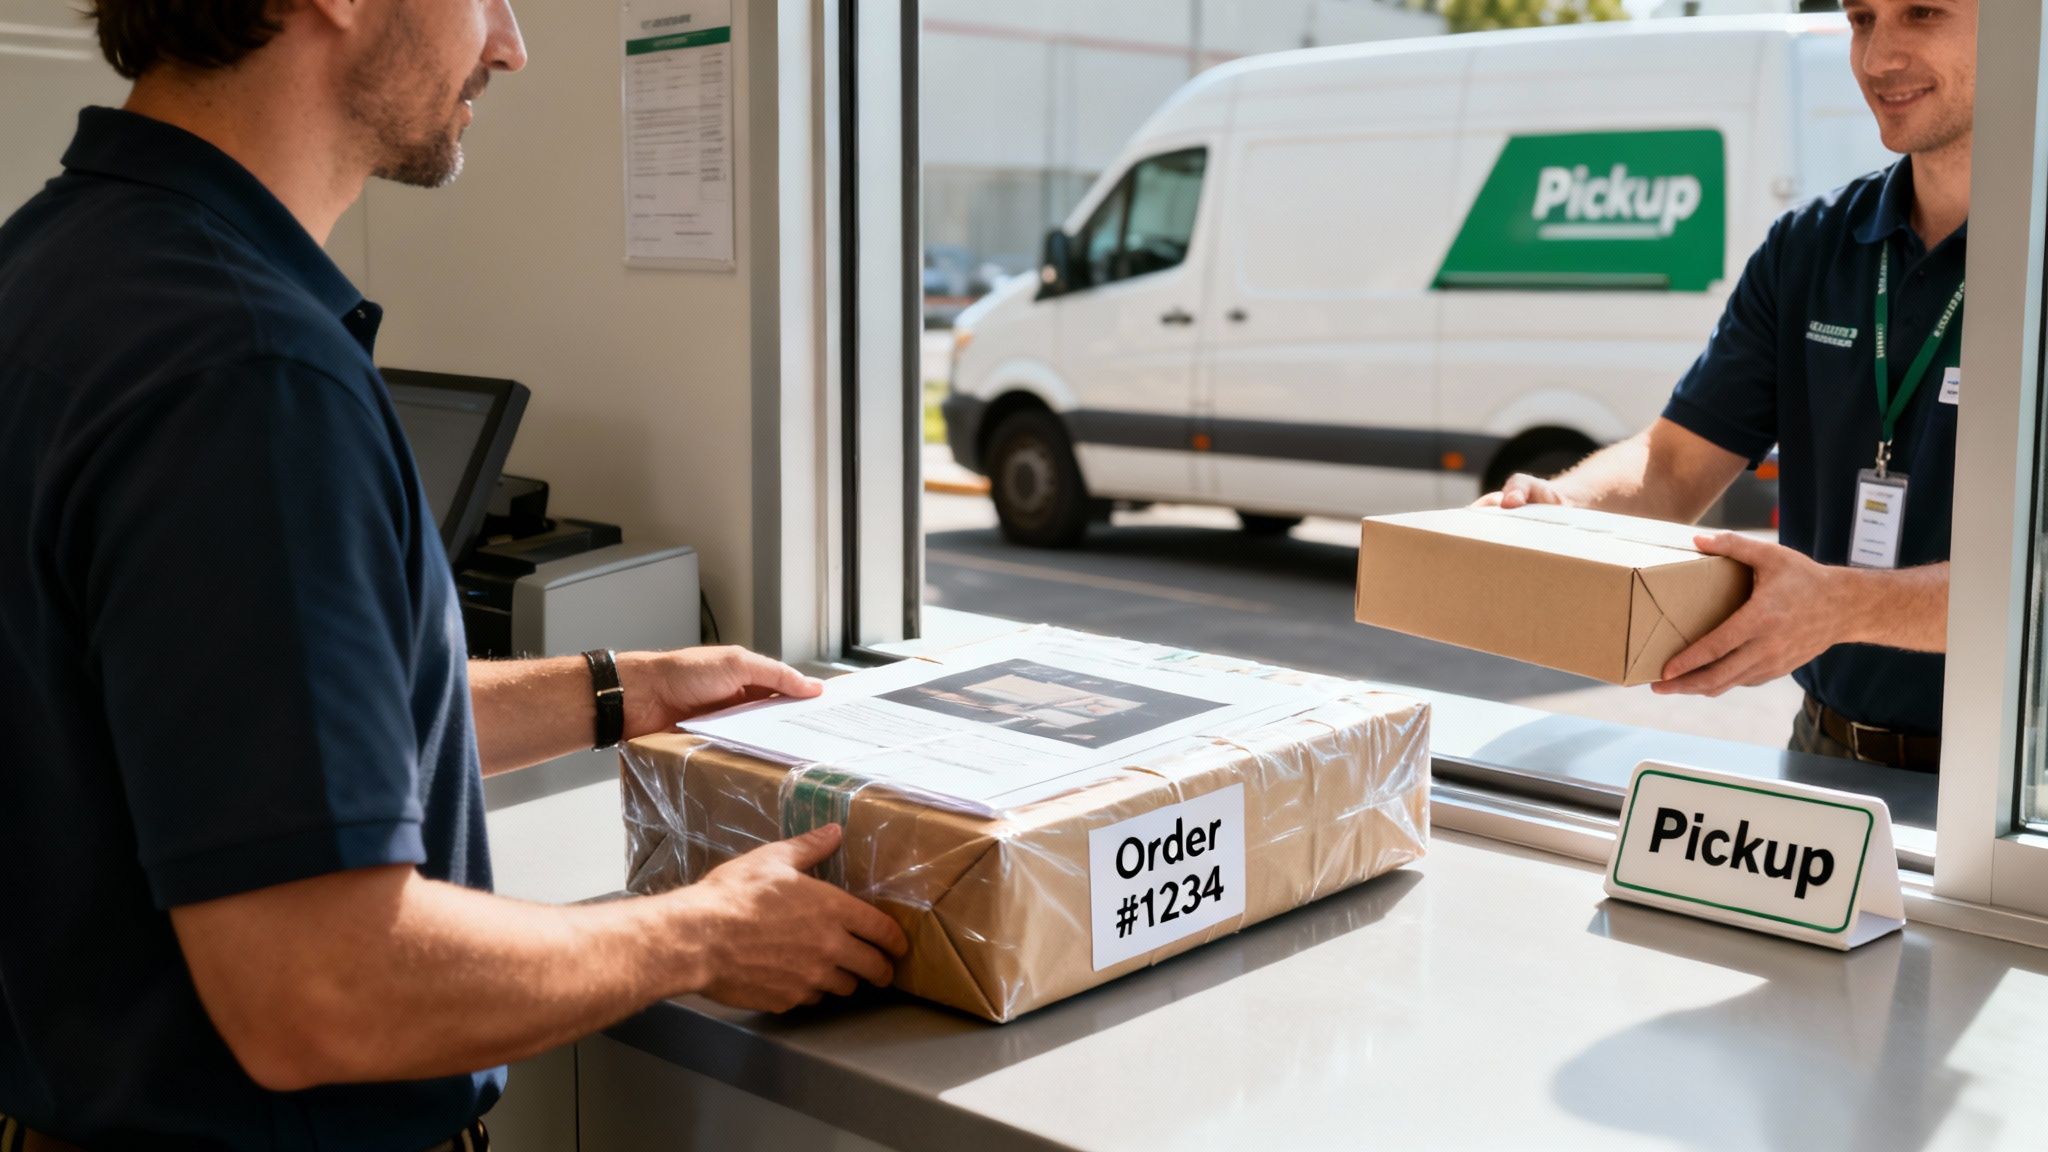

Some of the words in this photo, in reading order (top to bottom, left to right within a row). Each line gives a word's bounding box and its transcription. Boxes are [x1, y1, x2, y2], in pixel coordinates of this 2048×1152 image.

[1532, 164, 1701, 236] Pickup
[1115, 816, 1222, 879] Order
[1648, 807, 1834, 899] Pickup
[1115, 865, 1224, 938] #1234
